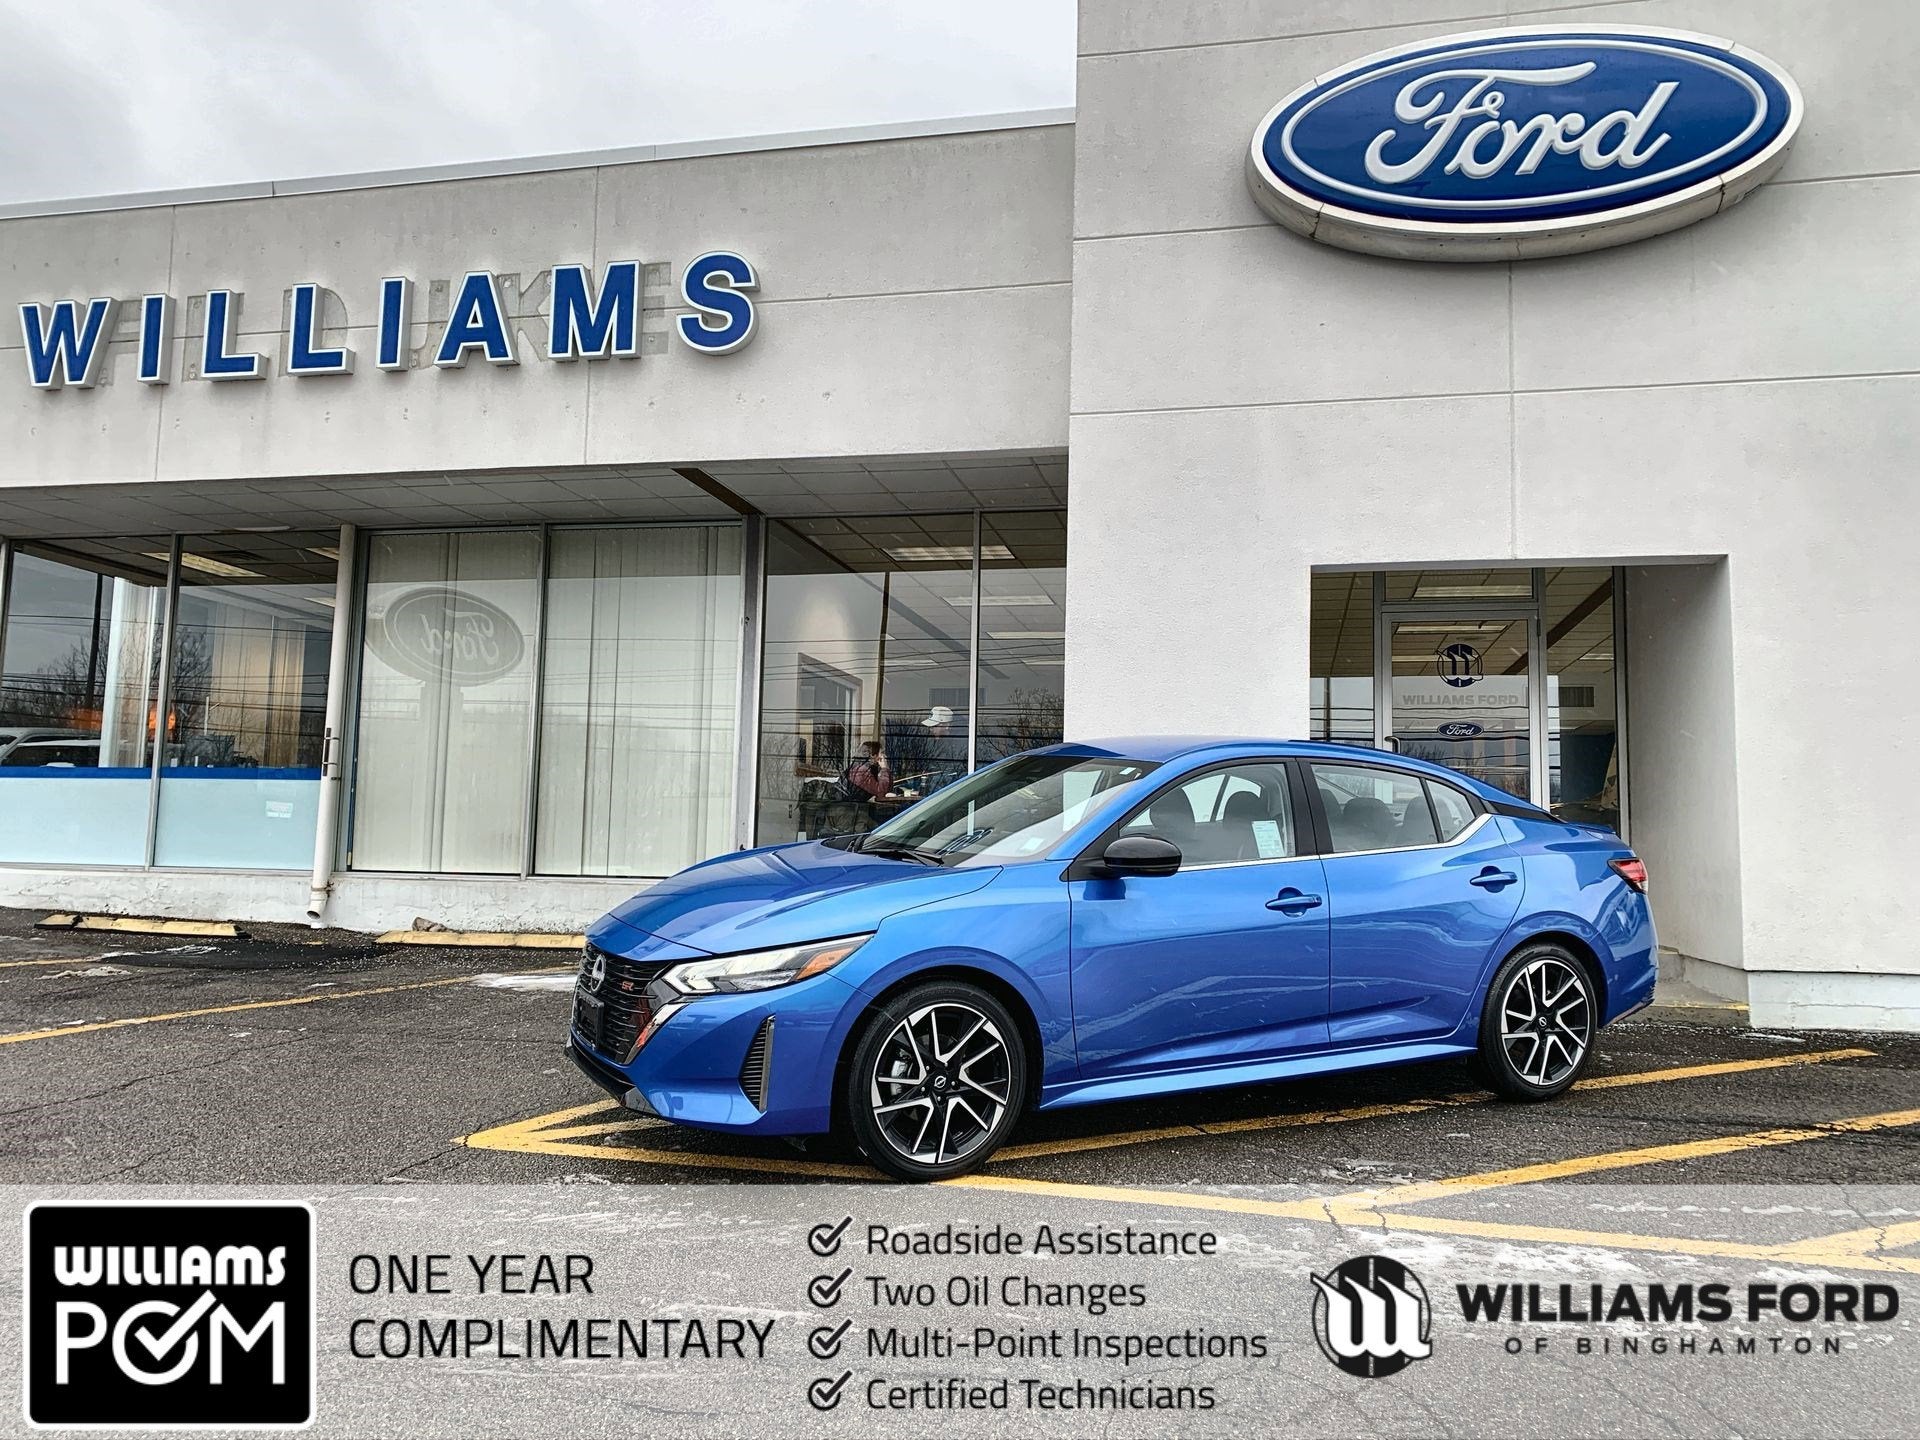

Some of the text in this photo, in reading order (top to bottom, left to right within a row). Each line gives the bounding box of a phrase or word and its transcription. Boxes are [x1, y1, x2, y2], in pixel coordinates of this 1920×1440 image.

[1364, 61, 1680, 183] Ford
[18, 251, 760, 391] WILLIAMS
[1402, 694, 1519, 706] WILLIAMS FORD
[1446, 723, 1474, 736] Ford
